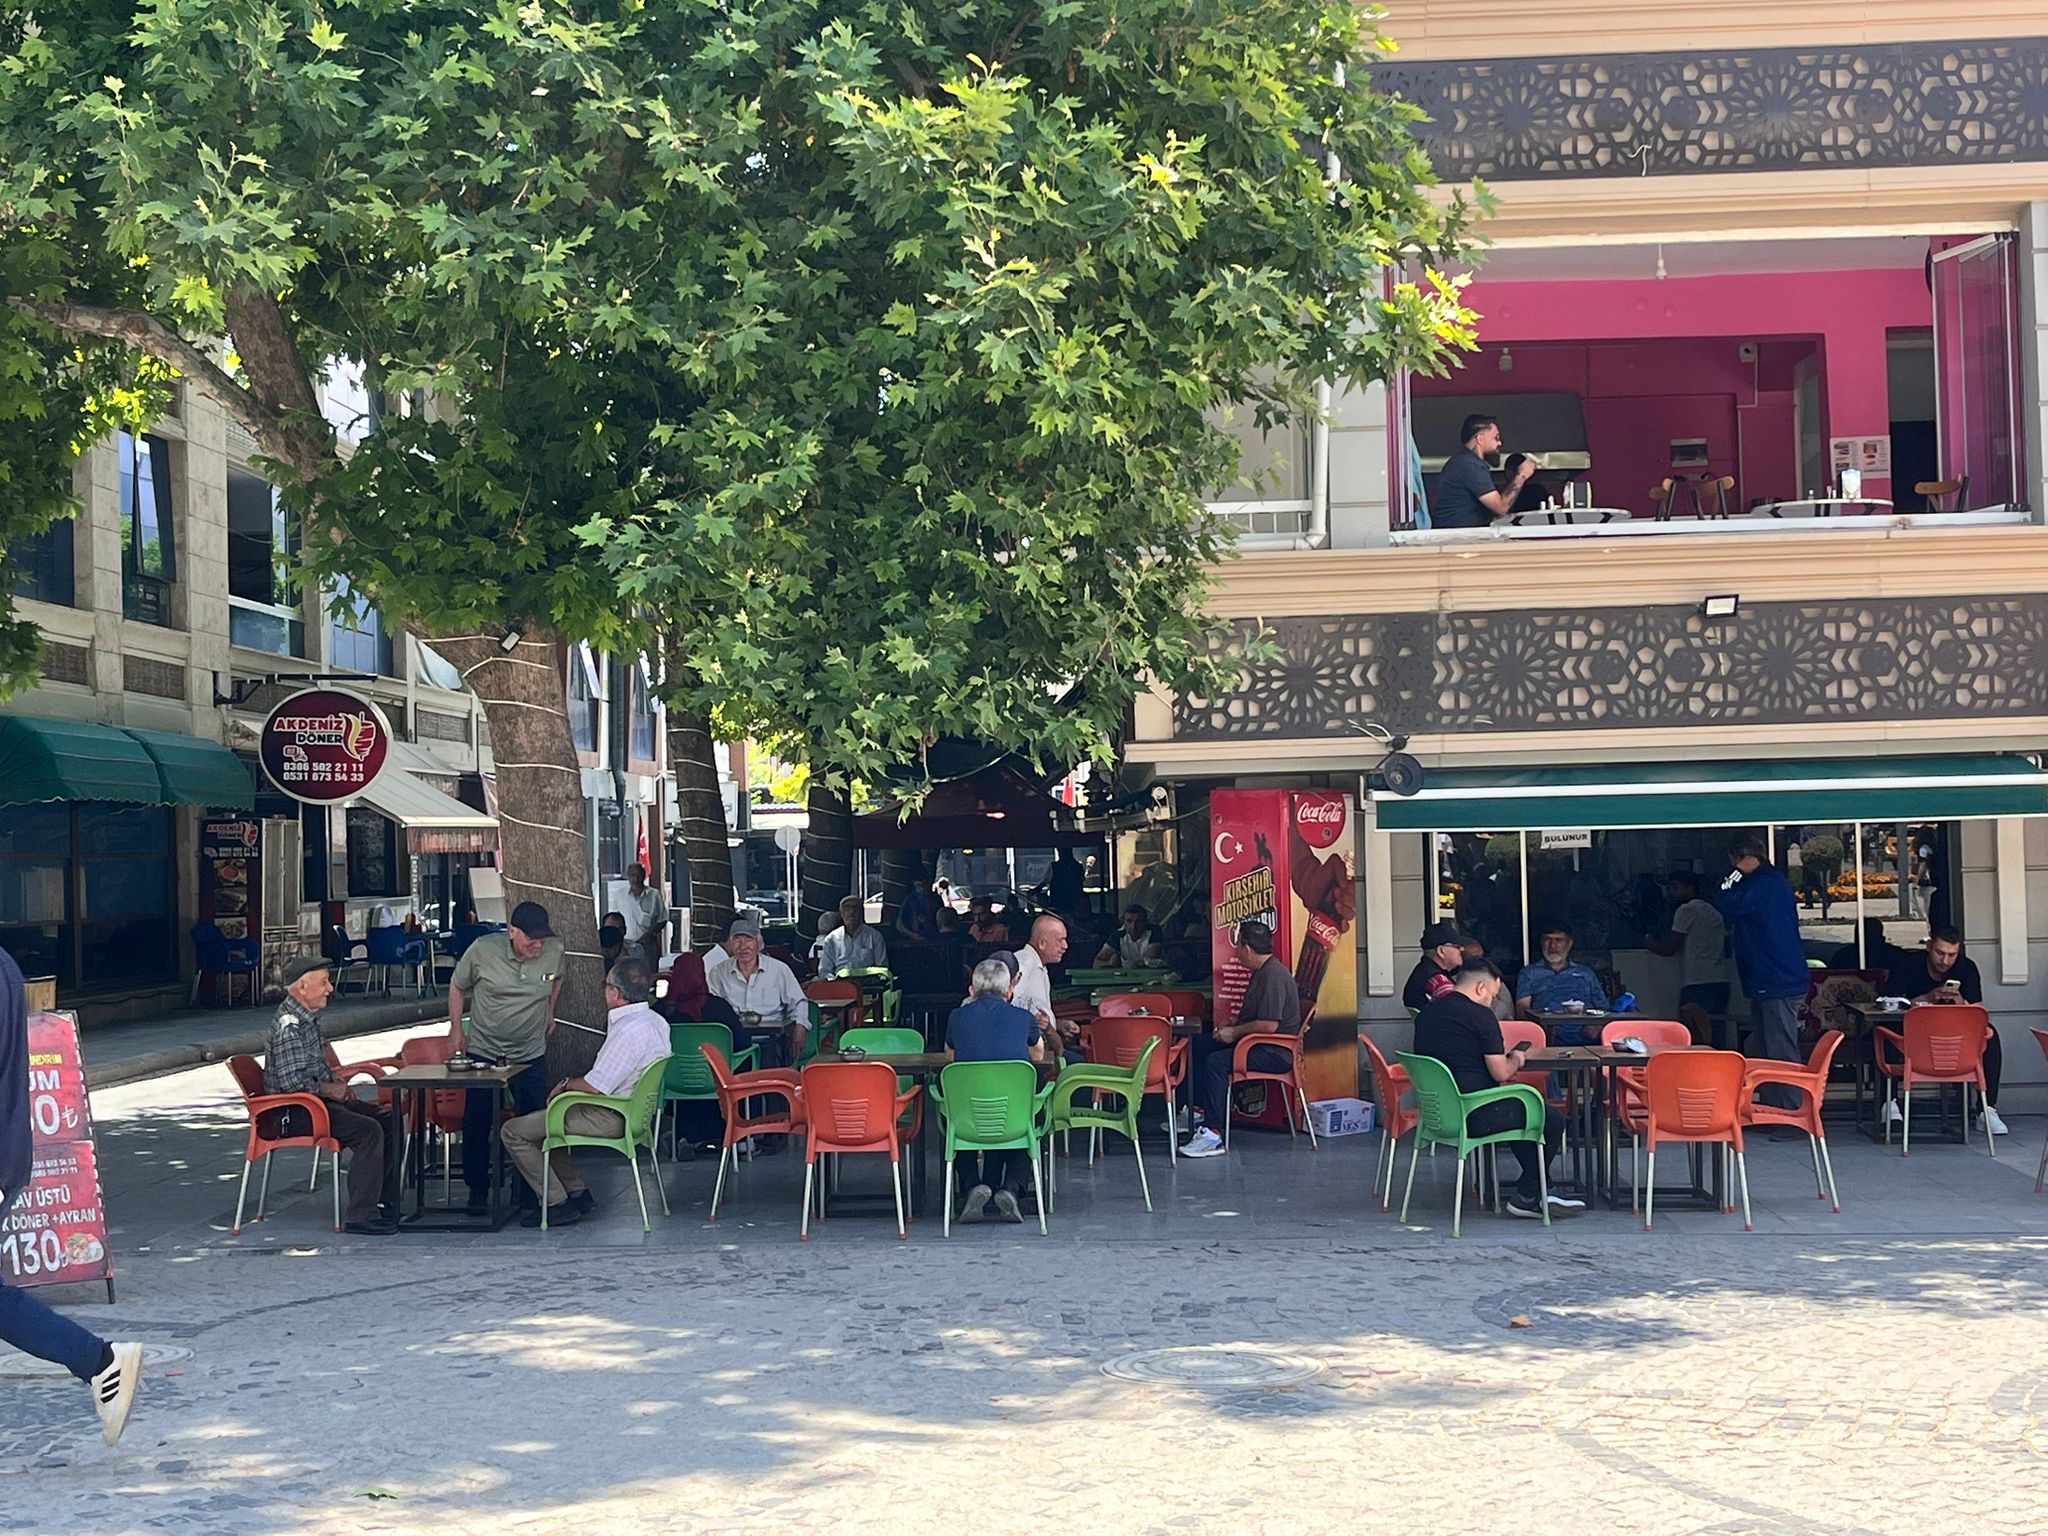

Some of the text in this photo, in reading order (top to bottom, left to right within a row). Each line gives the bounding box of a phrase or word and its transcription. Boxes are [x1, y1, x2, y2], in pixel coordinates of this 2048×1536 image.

[274, 715, 344, 731] AKDENİZ
[296, 731, 344, 744] DÖNER
[312, 762, 332, 772] 502
[334, 763, 347, 772] 21
[351, 763, 364, 772] 11
[283, 772, 309, 781] 0531
[334, 772, 348, 782] 54
[350, 773, 364, 782] 33
[1297, 801, 1343, 823] Coca-Cola
[1544, 833, 1588, 843] BULUNUR
[1217, 888, 1274, 926] MOTOSİKLET
[36, 1184, 71, 1207] ÜSTÜ
[12, 1213, 50, 1231] DÖNER
